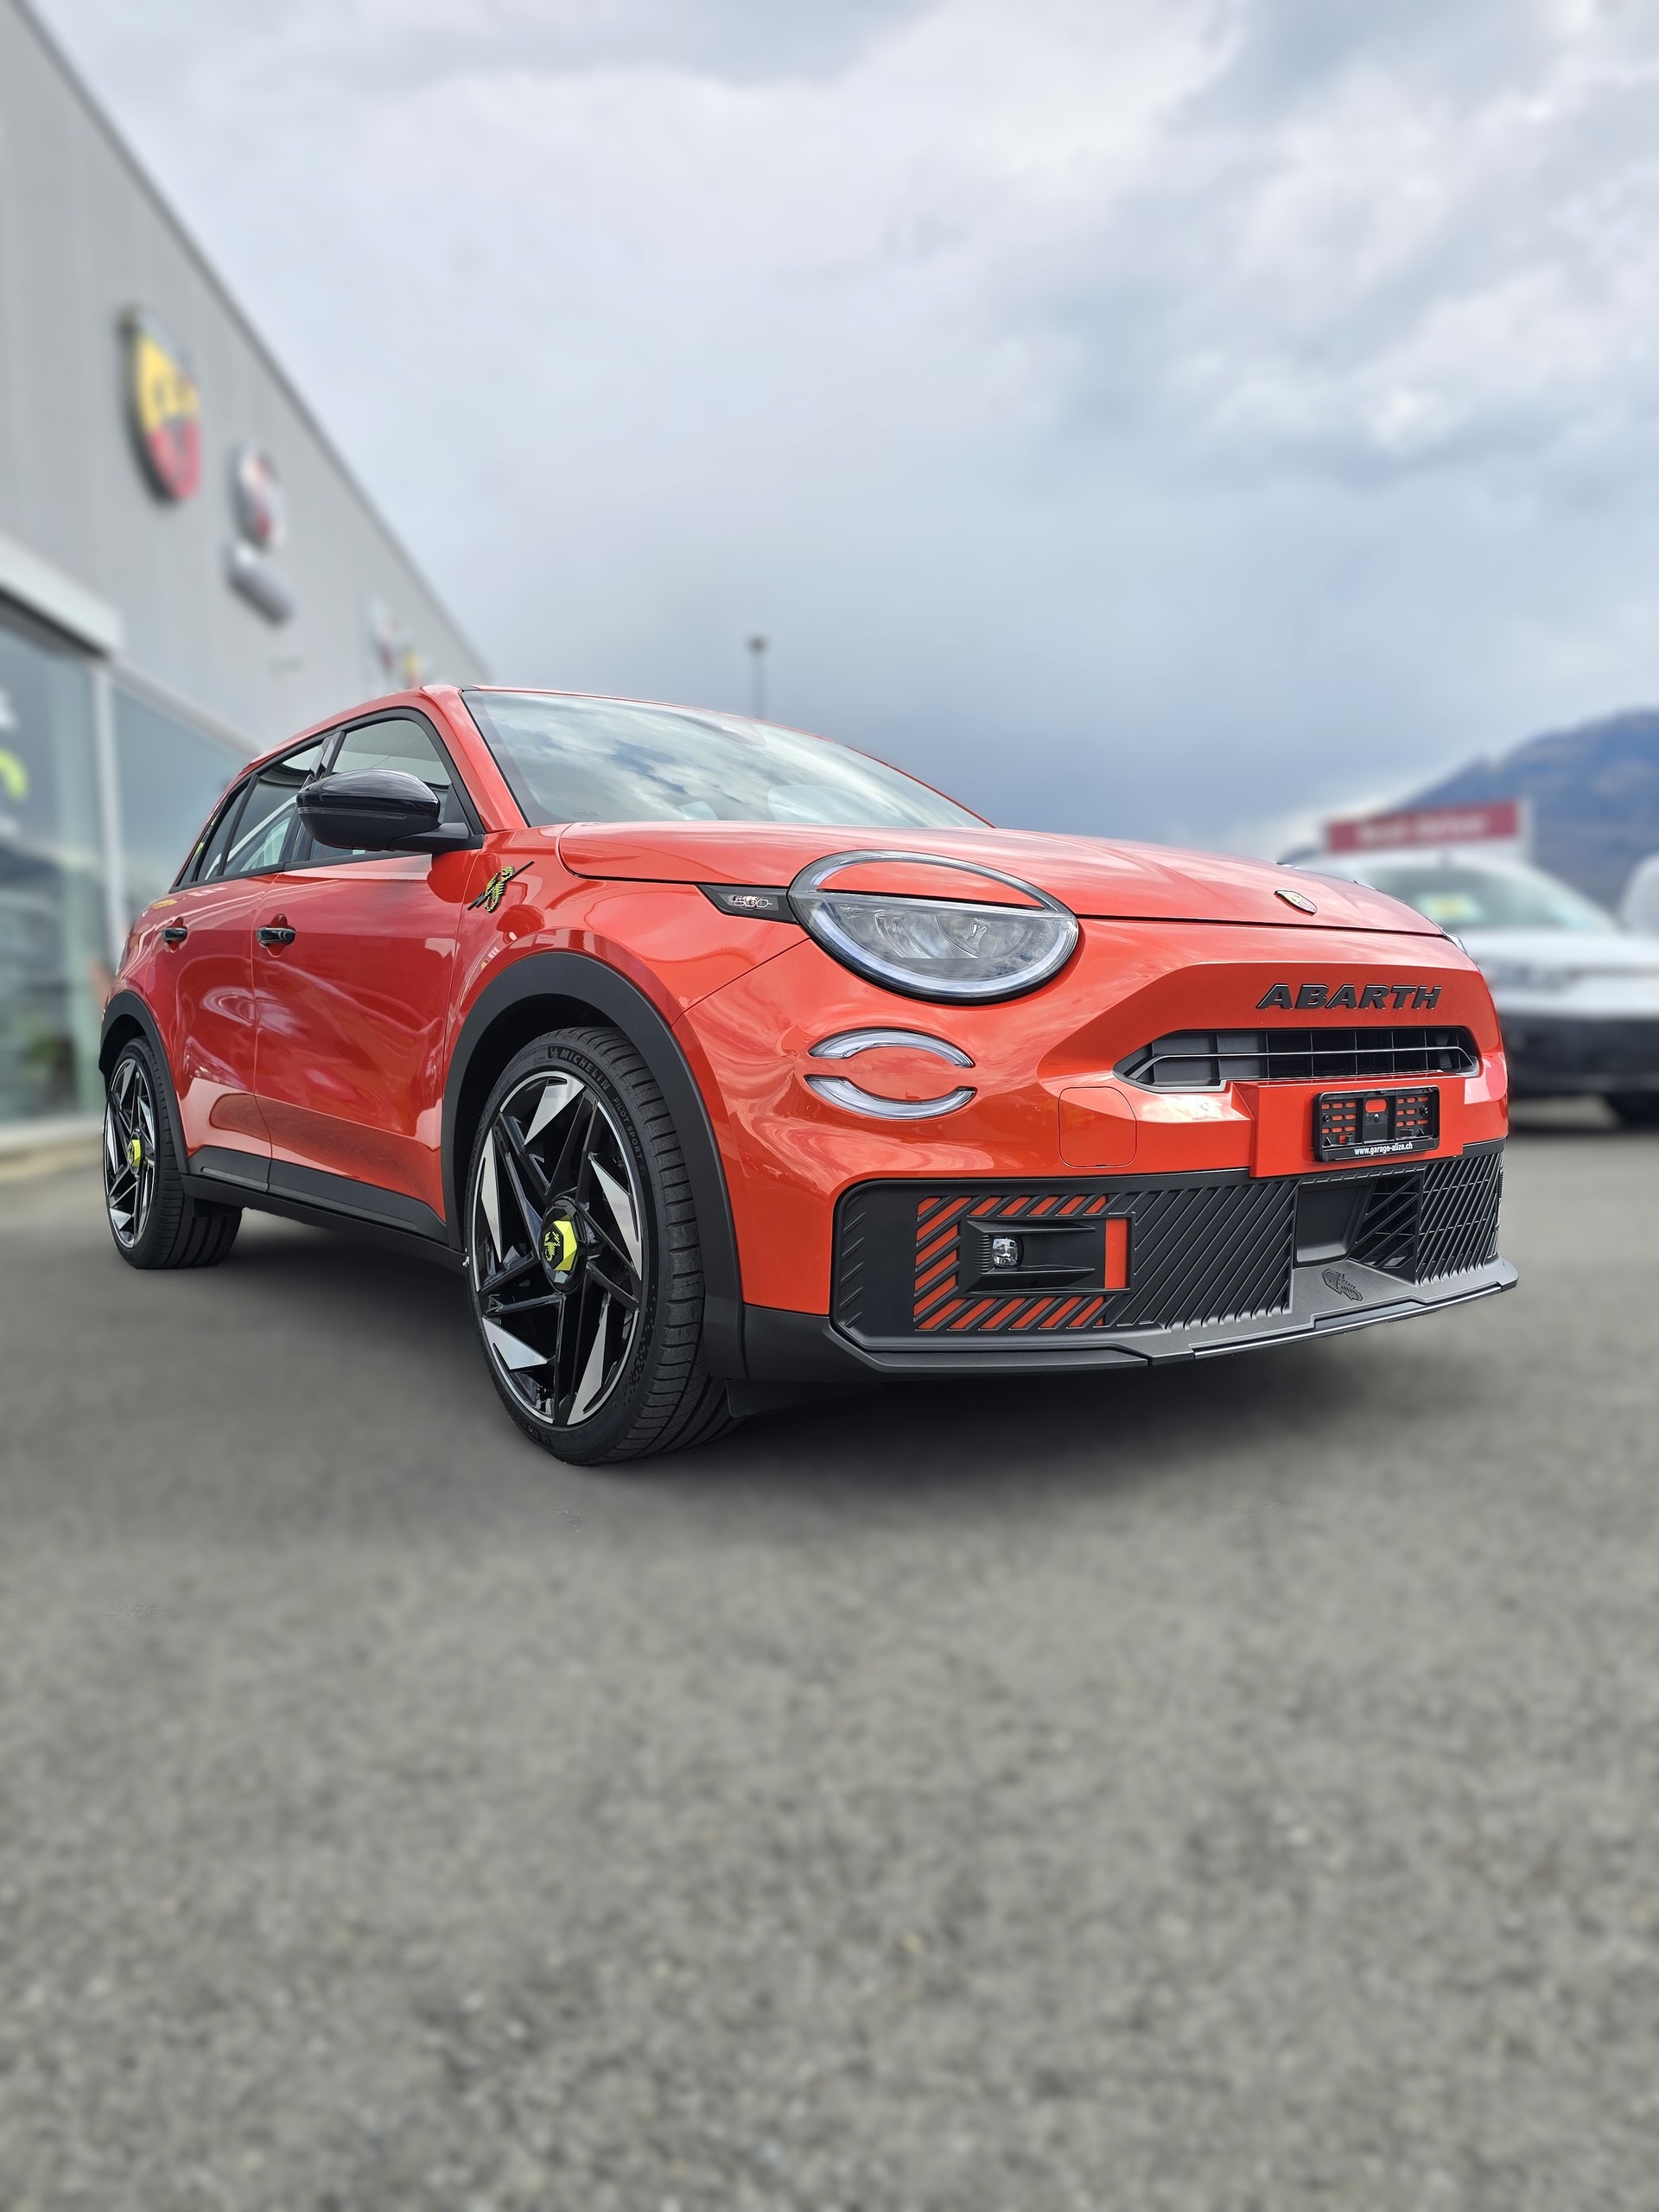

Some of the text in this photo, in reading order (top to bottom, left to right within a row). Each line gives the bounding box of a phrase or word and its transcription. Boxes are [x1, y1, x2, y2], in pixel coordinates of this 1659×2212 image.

[1255, 983, 1442, 1010] ABARTH
[560, 1048, 643, 1160] MICHELIN PILOT SPORT
[1354, 1141, 1413, 1155] www.garage-alize.ch
